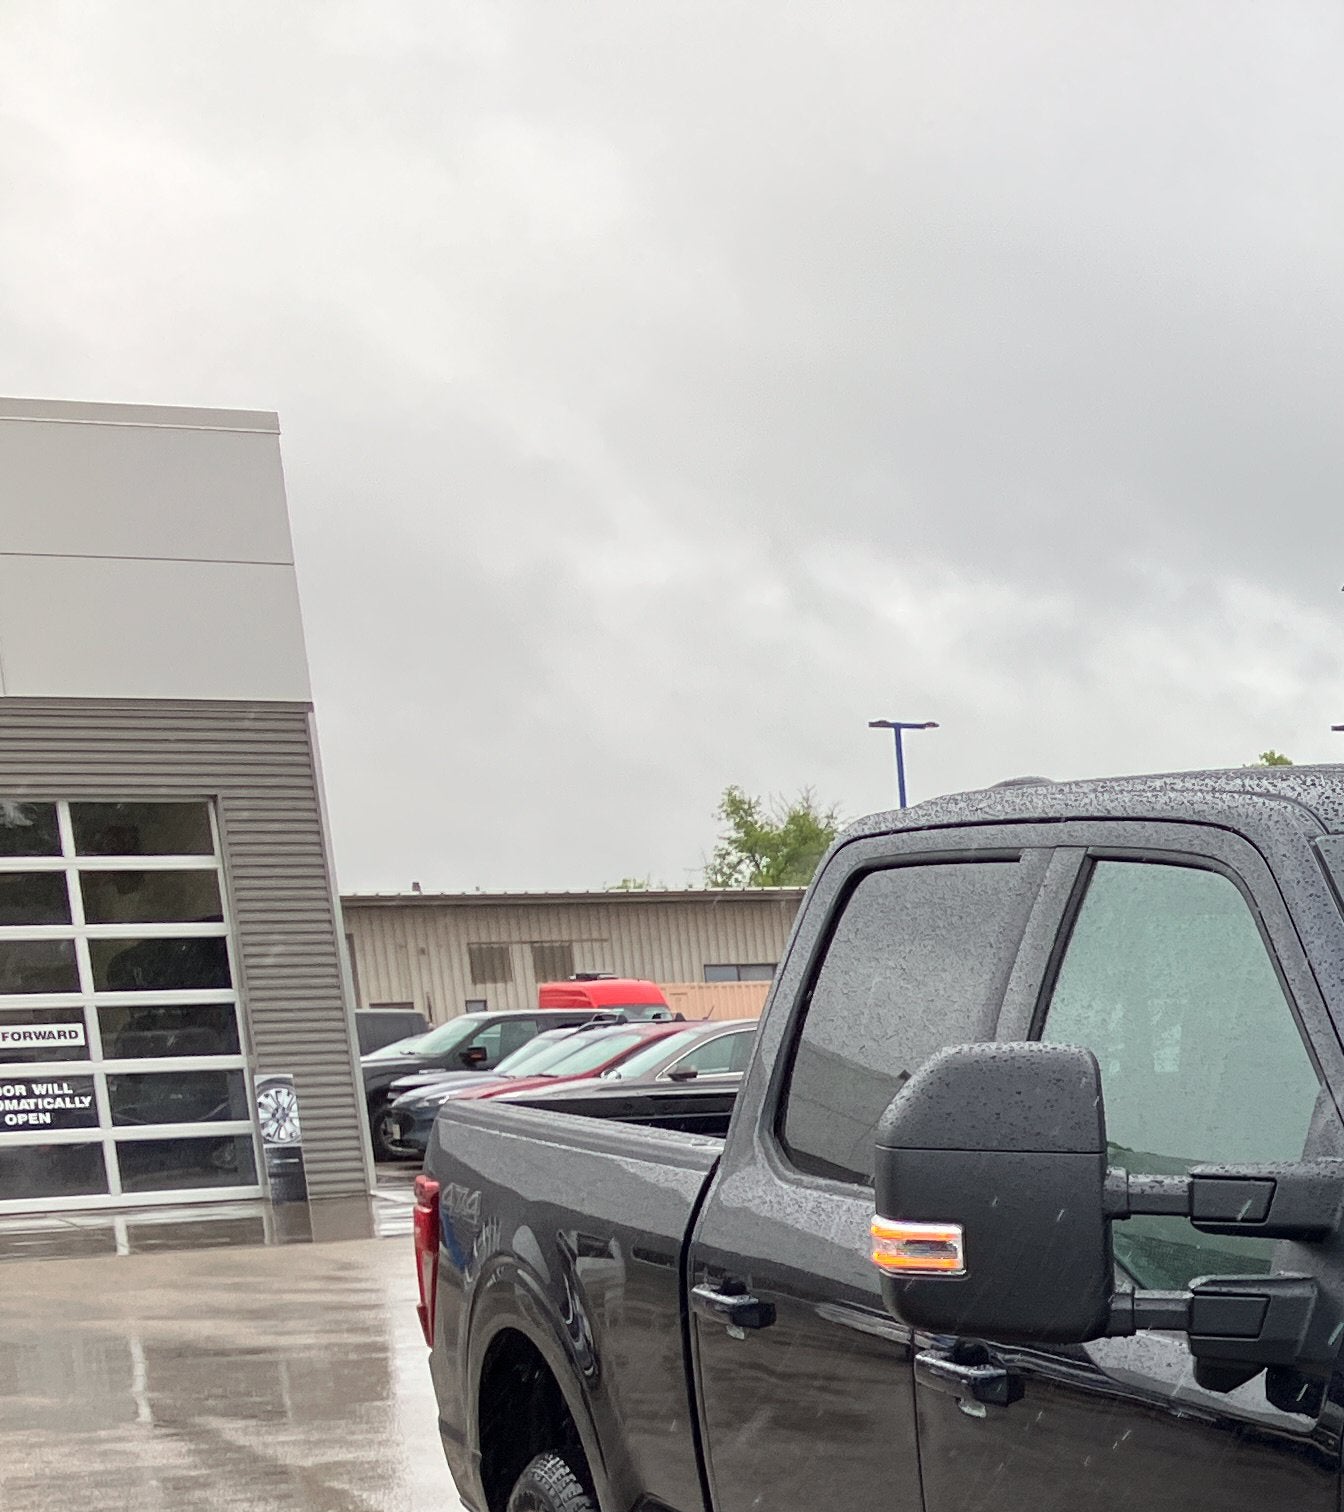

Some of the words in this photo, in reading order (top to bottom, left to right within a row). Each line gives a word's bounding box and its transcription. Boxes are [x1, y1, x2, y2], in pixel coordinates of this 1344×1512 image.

[1, 1030, 79, 1041] FORWARD
[0, 1084, 26, 1096] OR
[32, 1083, 73, 1095] WILL
[5, 1112, 51, 1125] OPEN
